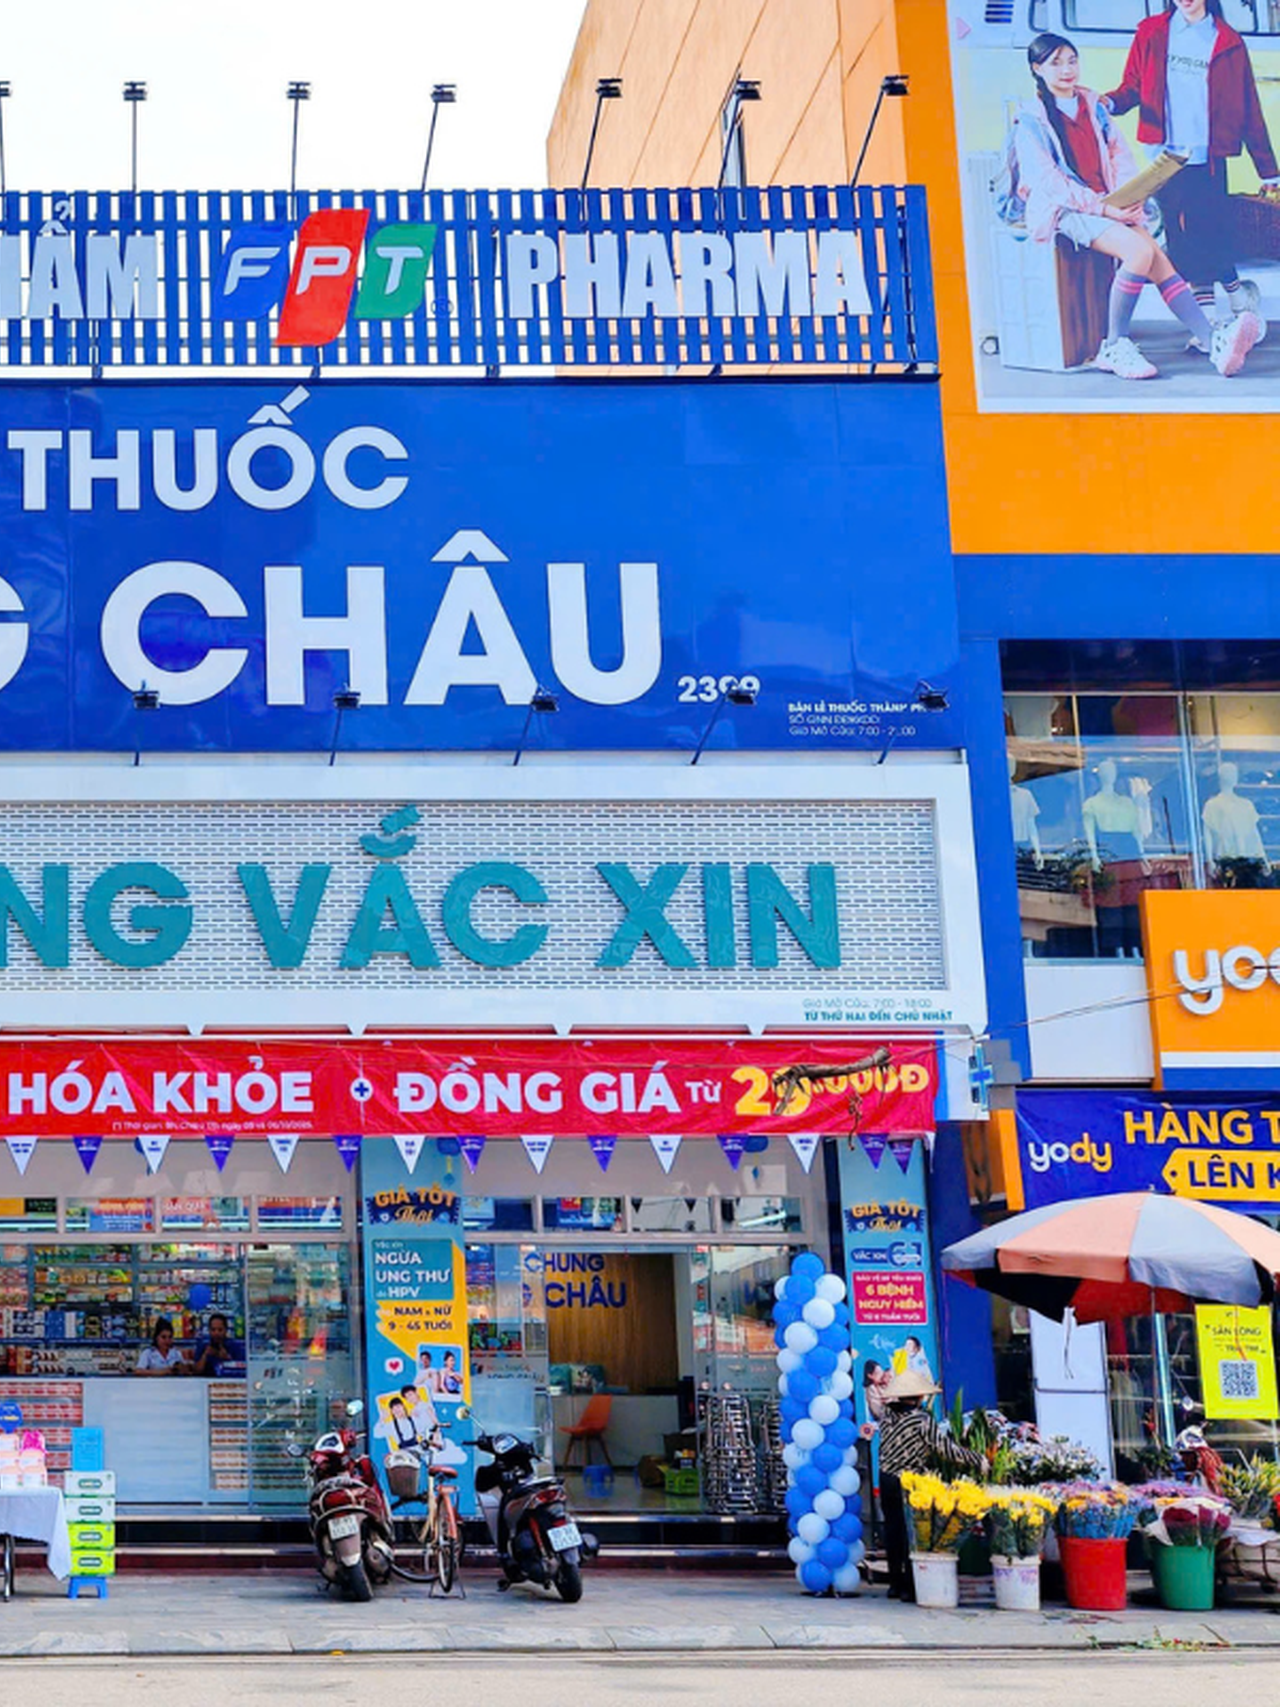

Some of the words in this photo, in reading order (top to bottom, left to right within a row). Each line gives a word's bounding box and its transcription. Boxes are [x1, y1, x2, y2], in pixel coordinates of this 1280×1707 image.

[506, 231, 874, 318] PHARMA
[7, 384, 410, 511] THUỐC
[100, 529, 663, 706] CHÂU
[236, 803, 549, 969] VẮC
[595, 862, 842, 969] XIN
[846, 1011, 866, 1021] HAI
[8, 1059, 136, 1116] HÓA
[153, 1056, 315, 1116] KHỎE
[393, 1056, 564, 1115] ĐỒNG
[580, 1061, 681, 1114] GIÁ
[1124, 1102, 1254, 1145] HÀNG
[1028, 1132, 1113, 1173] yody
[1188, 1153, 1255, 1189] LÊN
[375, 1182, 411, 1207] GIÁ
[416, 1181, 457, 1207] TỐT
[375, 1269, 412, 1283] UNG
[415, 1267, 452, 1283] THƯ
[388, 1286, 420, 1298] HPV
[545, 1274, 627, 1309] CHÂU
[865, 1284, 875, 1296] 6
